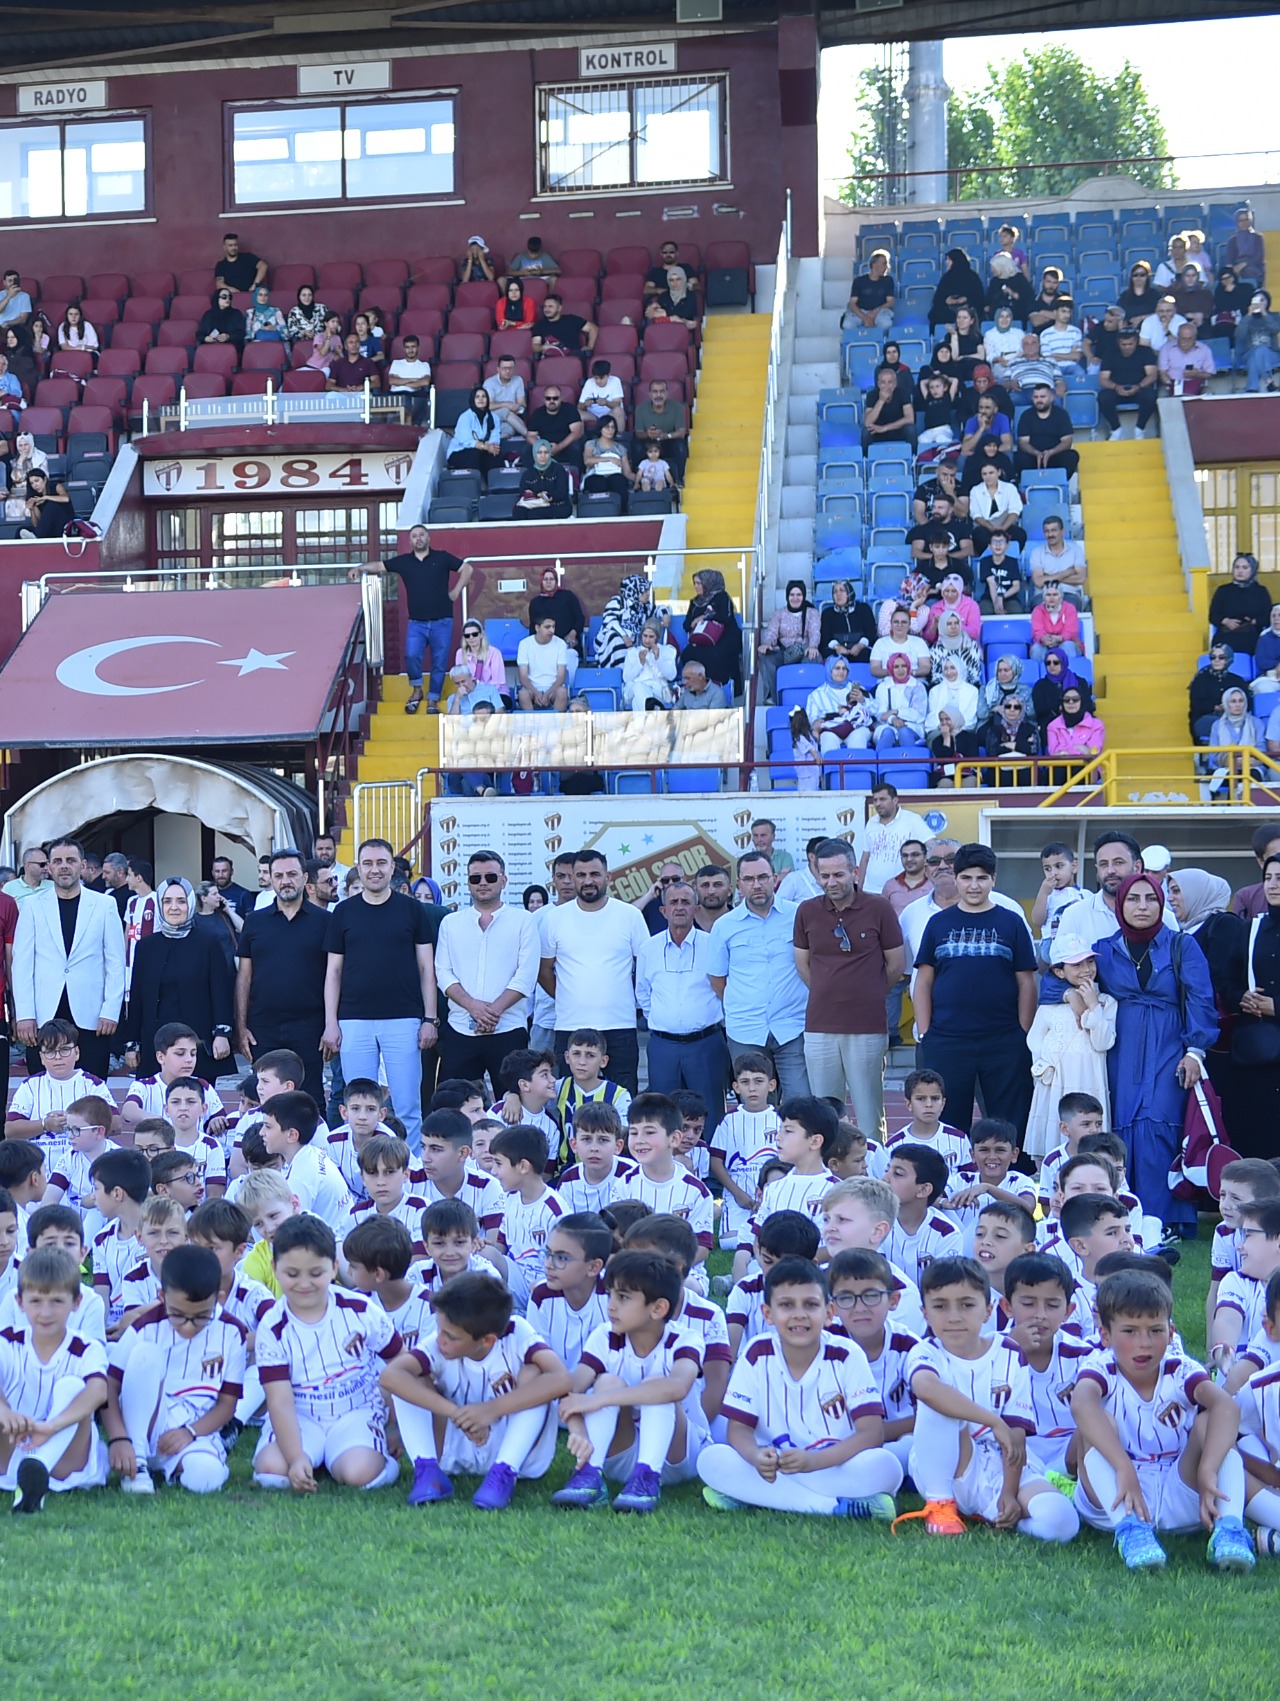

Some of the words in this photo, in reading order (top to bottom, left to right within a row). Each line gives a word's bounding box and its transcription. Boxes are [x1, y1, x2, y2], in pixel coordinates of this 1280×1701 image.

[586, 49, 668, 71] KONTROL
[333, 69, 355, 86] TV
[34, 87, 87, 106] RADYO
[195, 458, 370, 490] 1984
[606, 866, 654, 903] EGÖL
[651, 844, 713, 877] SOR
